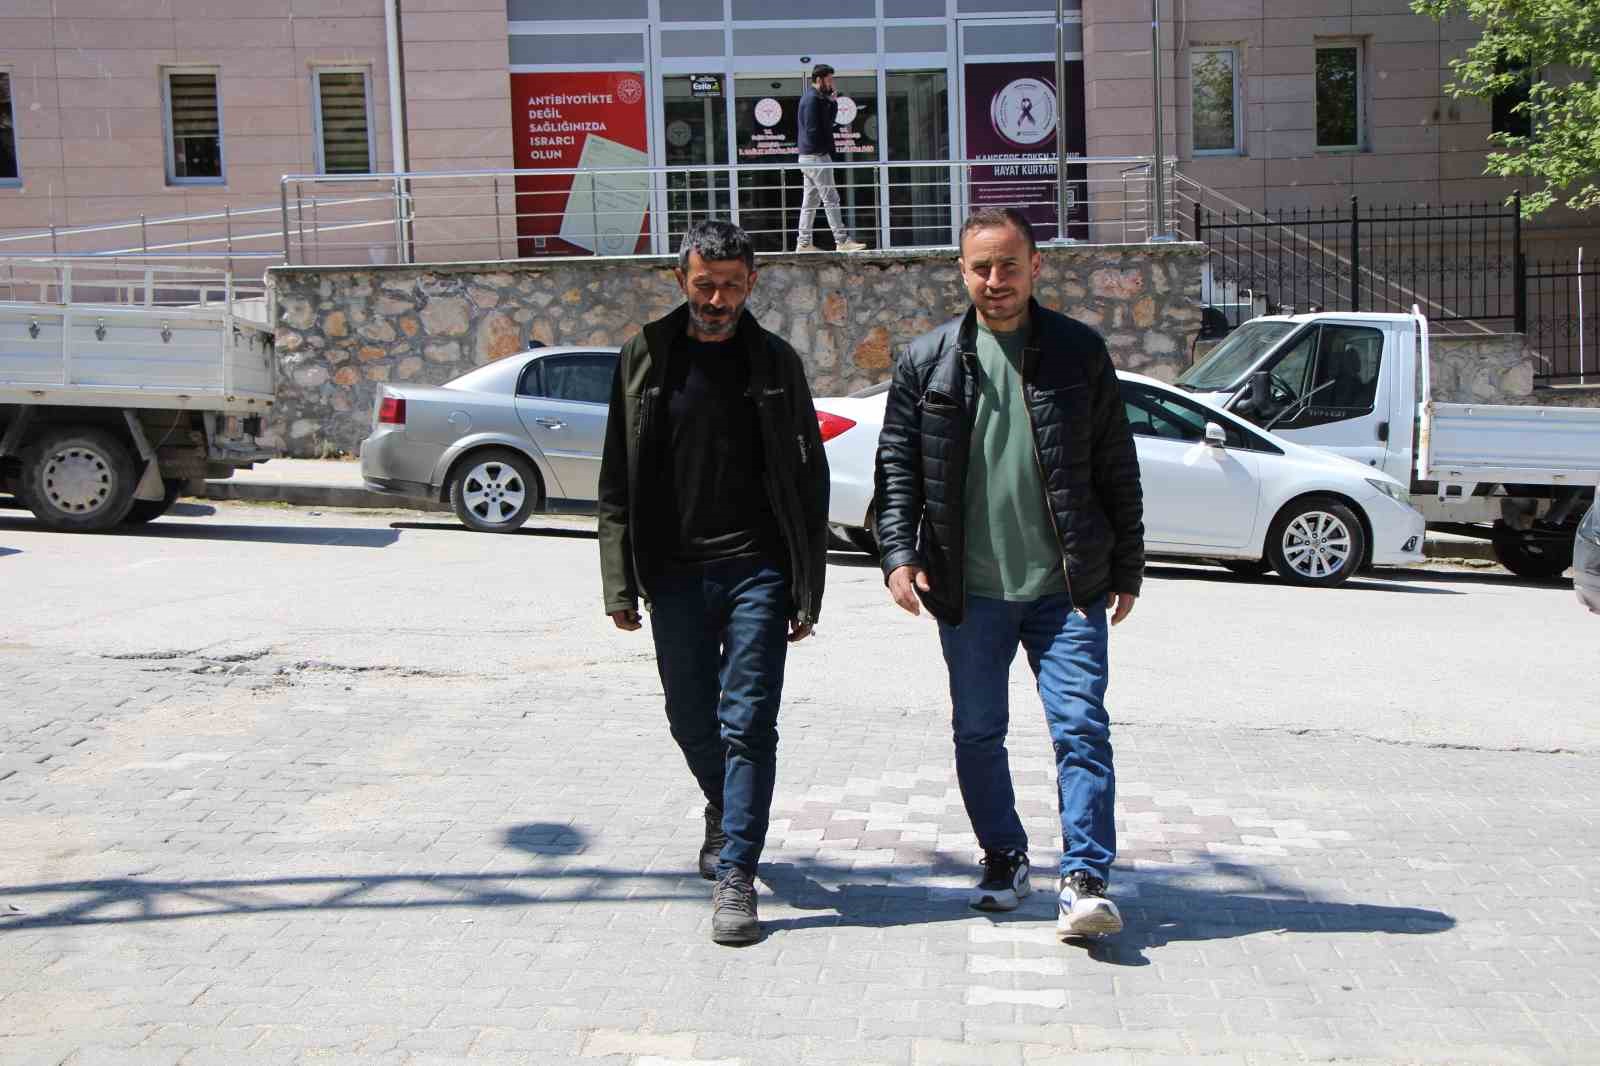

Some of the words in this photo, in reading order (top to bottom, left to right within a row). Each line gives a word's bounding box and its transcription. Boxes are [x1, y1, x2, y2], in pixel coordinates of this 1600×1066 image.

[528, 93, 613, 105] ANTİBİYOTİKTE
[529, 108, 562, 119] DEĞİL
[529, 121, 607, 133] SAĞLIĞINIZDA
[530, 136, 575, 146] ISRARCI
[531, 150, 562, 159] OLUN
[994, 165, 1019, 176] HAYAT
[1022, 165, 1057, 175] KURTARI
